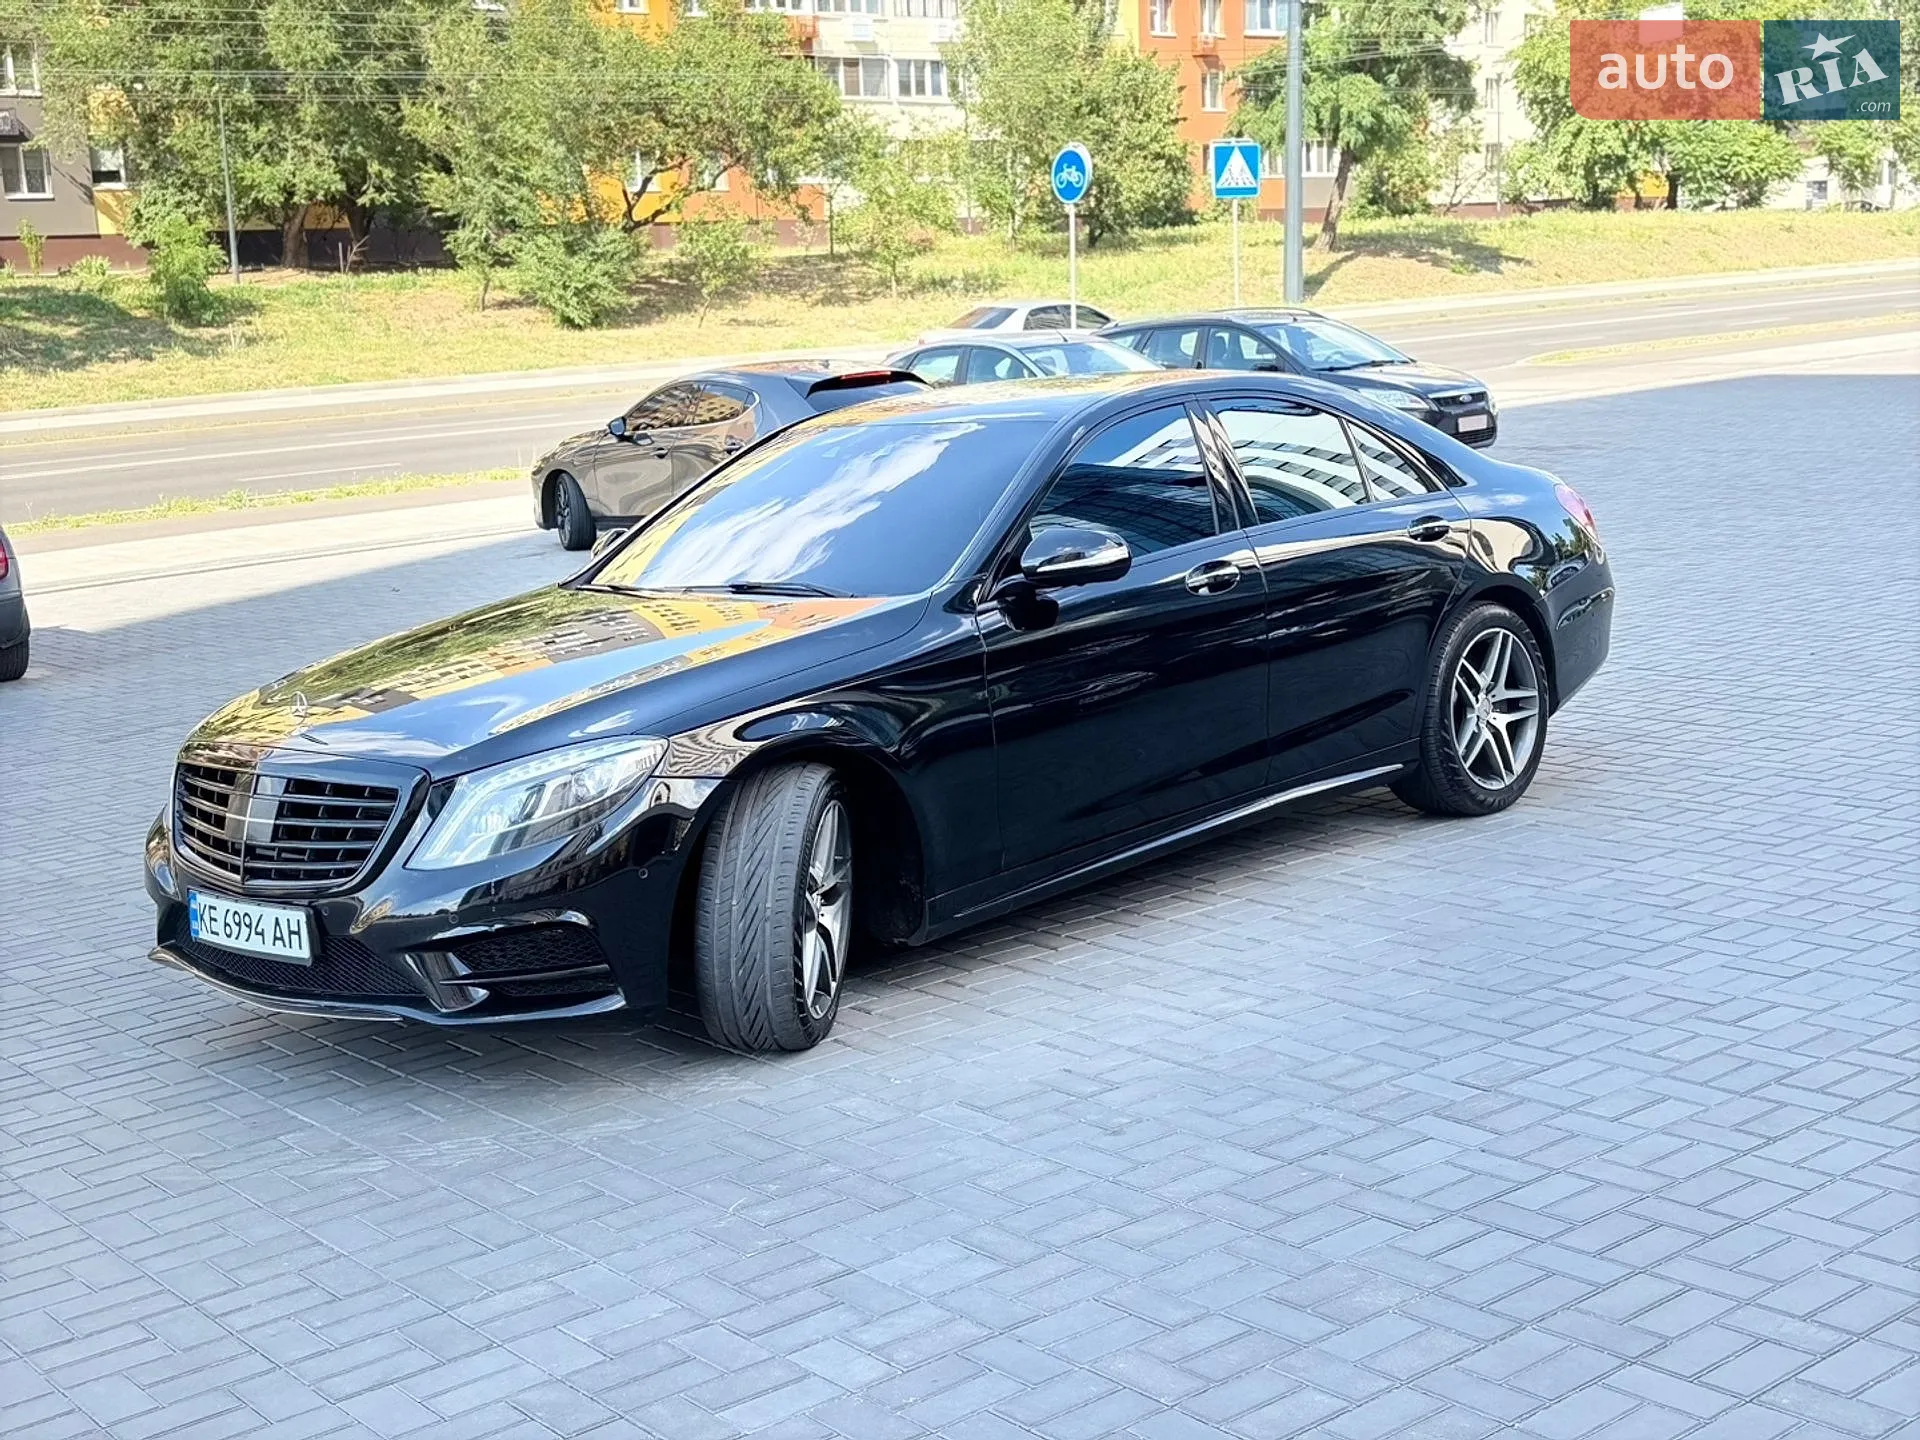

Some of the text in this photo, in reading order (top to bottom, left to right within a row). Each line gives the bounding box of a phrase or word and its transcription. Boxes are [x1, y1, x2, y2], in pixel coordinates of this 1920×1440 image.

[198, 902, 303, 950] KE 6994 AH
